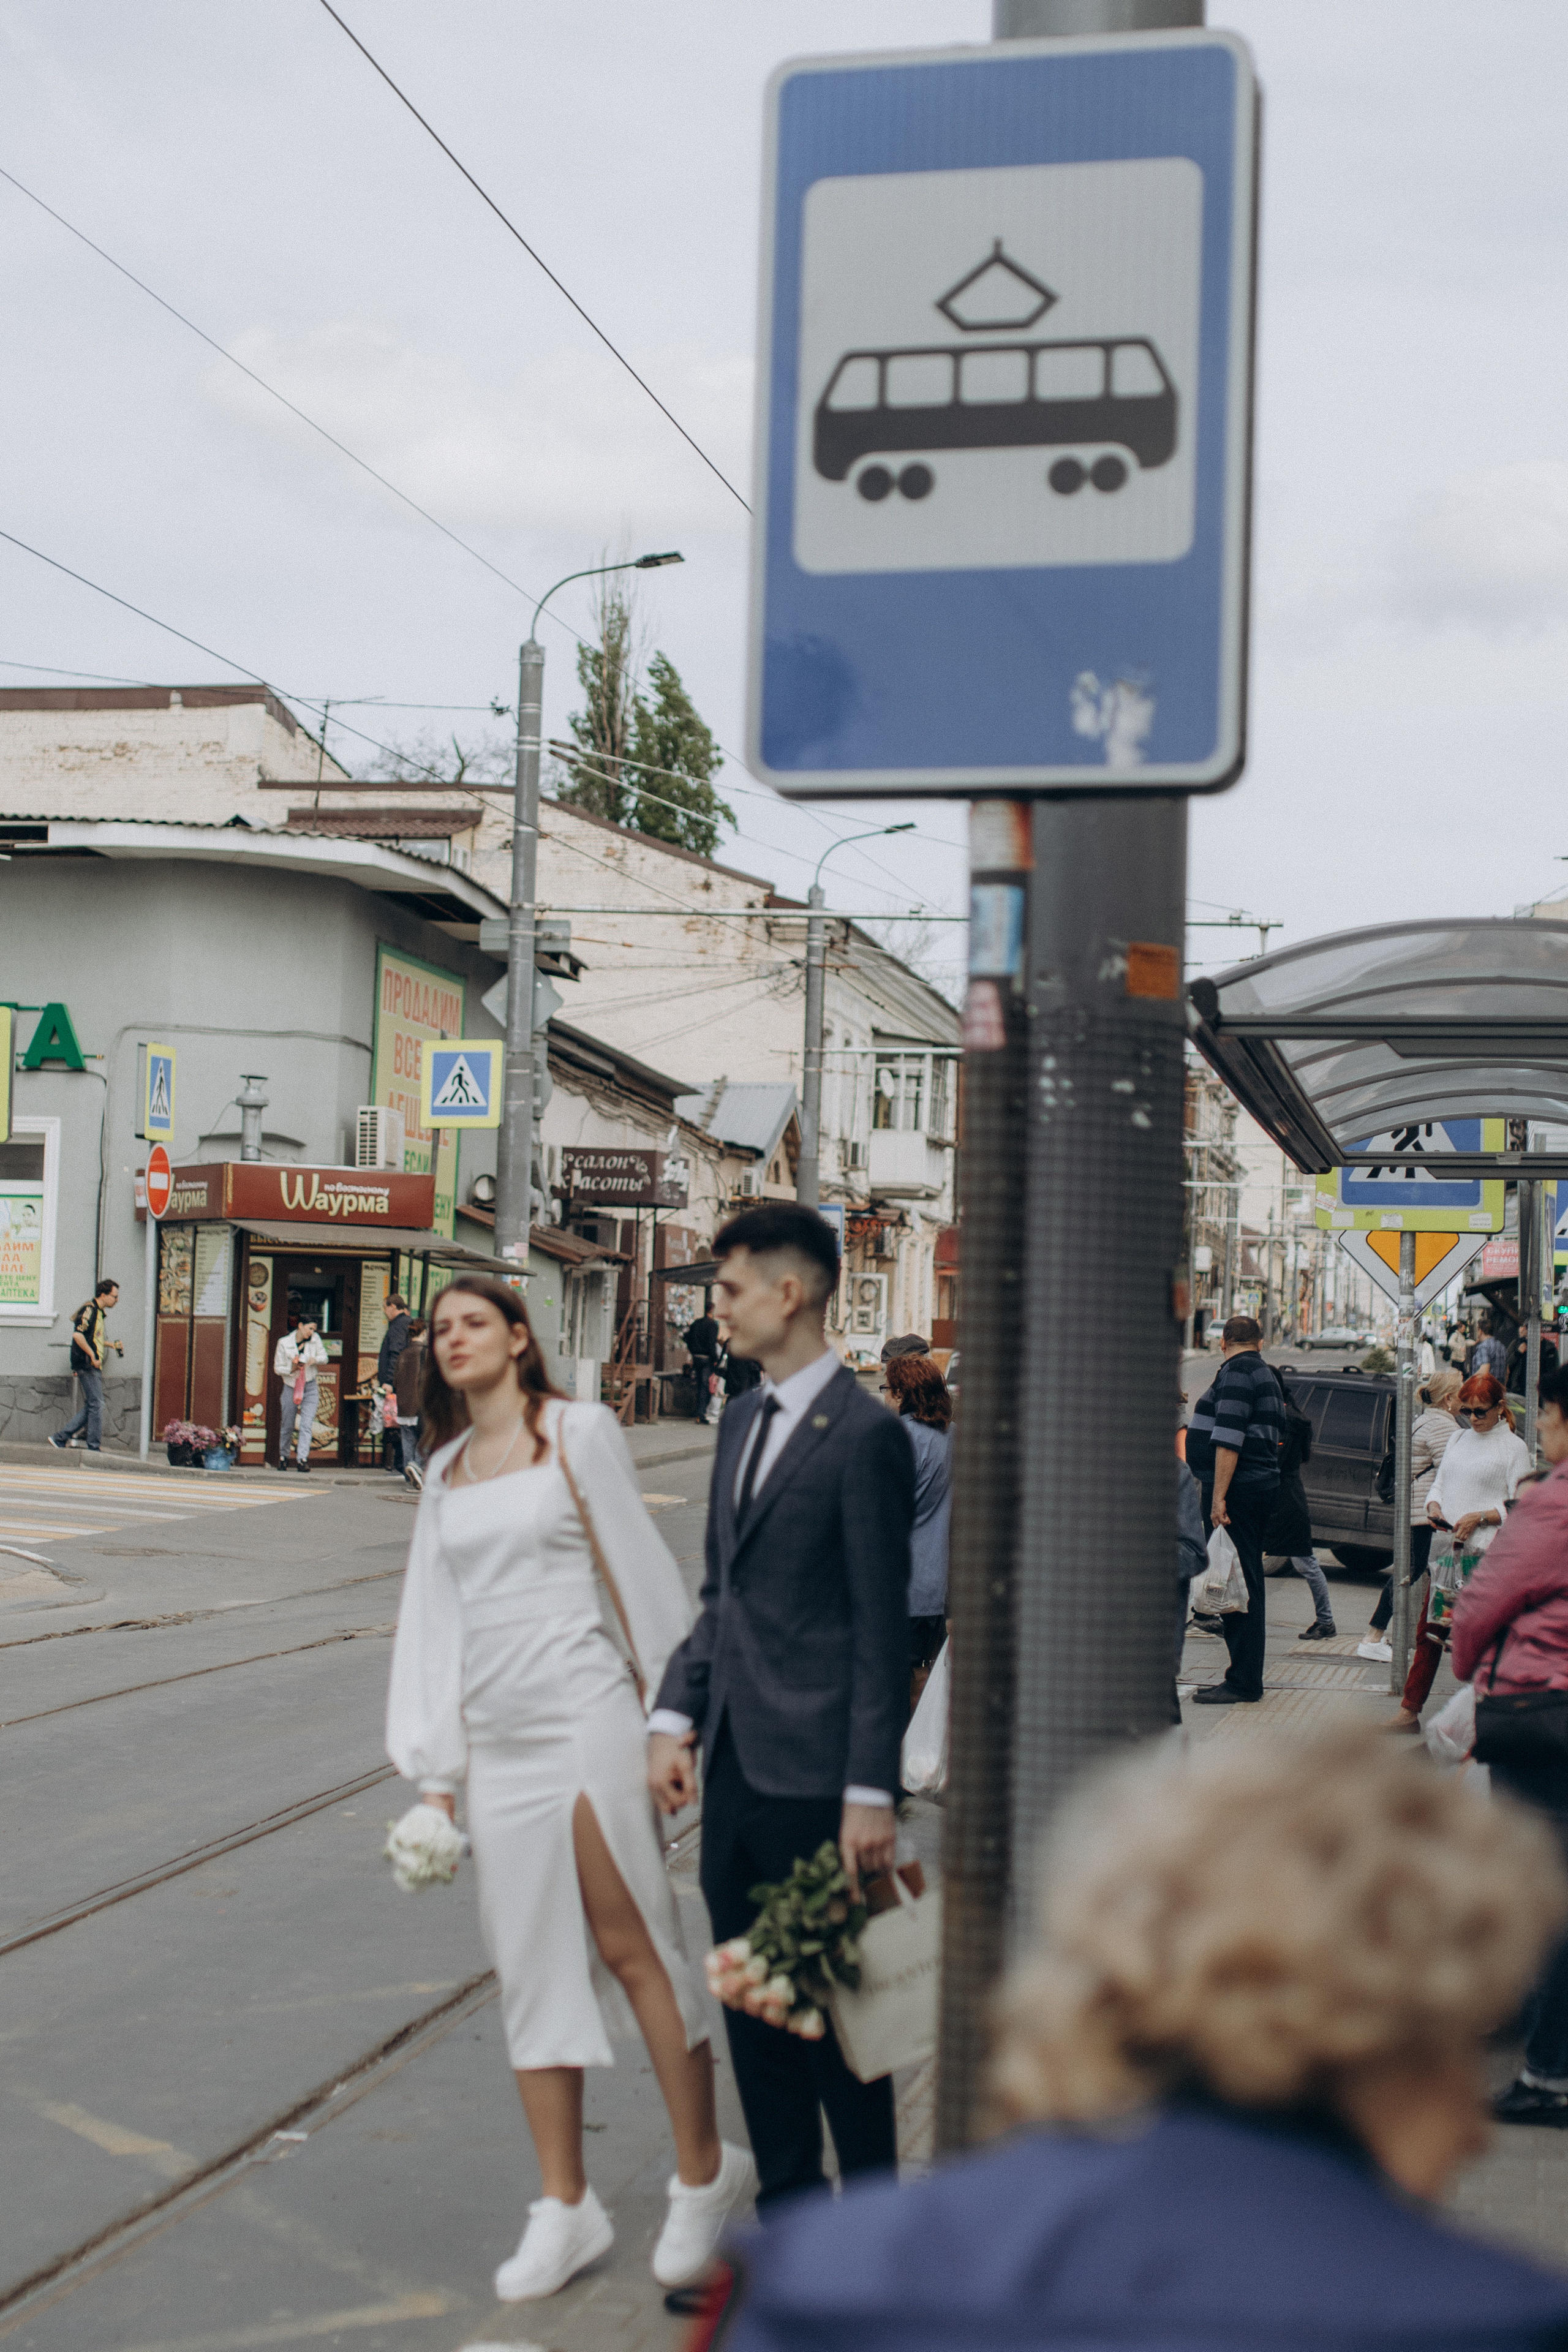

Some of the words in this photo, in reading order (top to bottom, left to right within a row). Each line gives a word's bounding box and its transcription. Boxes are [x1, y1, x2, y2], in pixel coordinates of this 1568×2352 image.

[383, 967, 461, 1036] ПРОДАДИМ
[15, 1000, 86, 1069] А
[394, 1032, 421, 1082] ВСЕ
[574, 1155, 630, 1170] салон
[170, 1172, 208, 1214] аурма
[280, 1170, 389, 1217] Шаурма
[1, 1288, 35, 1298] АПТЕКА
